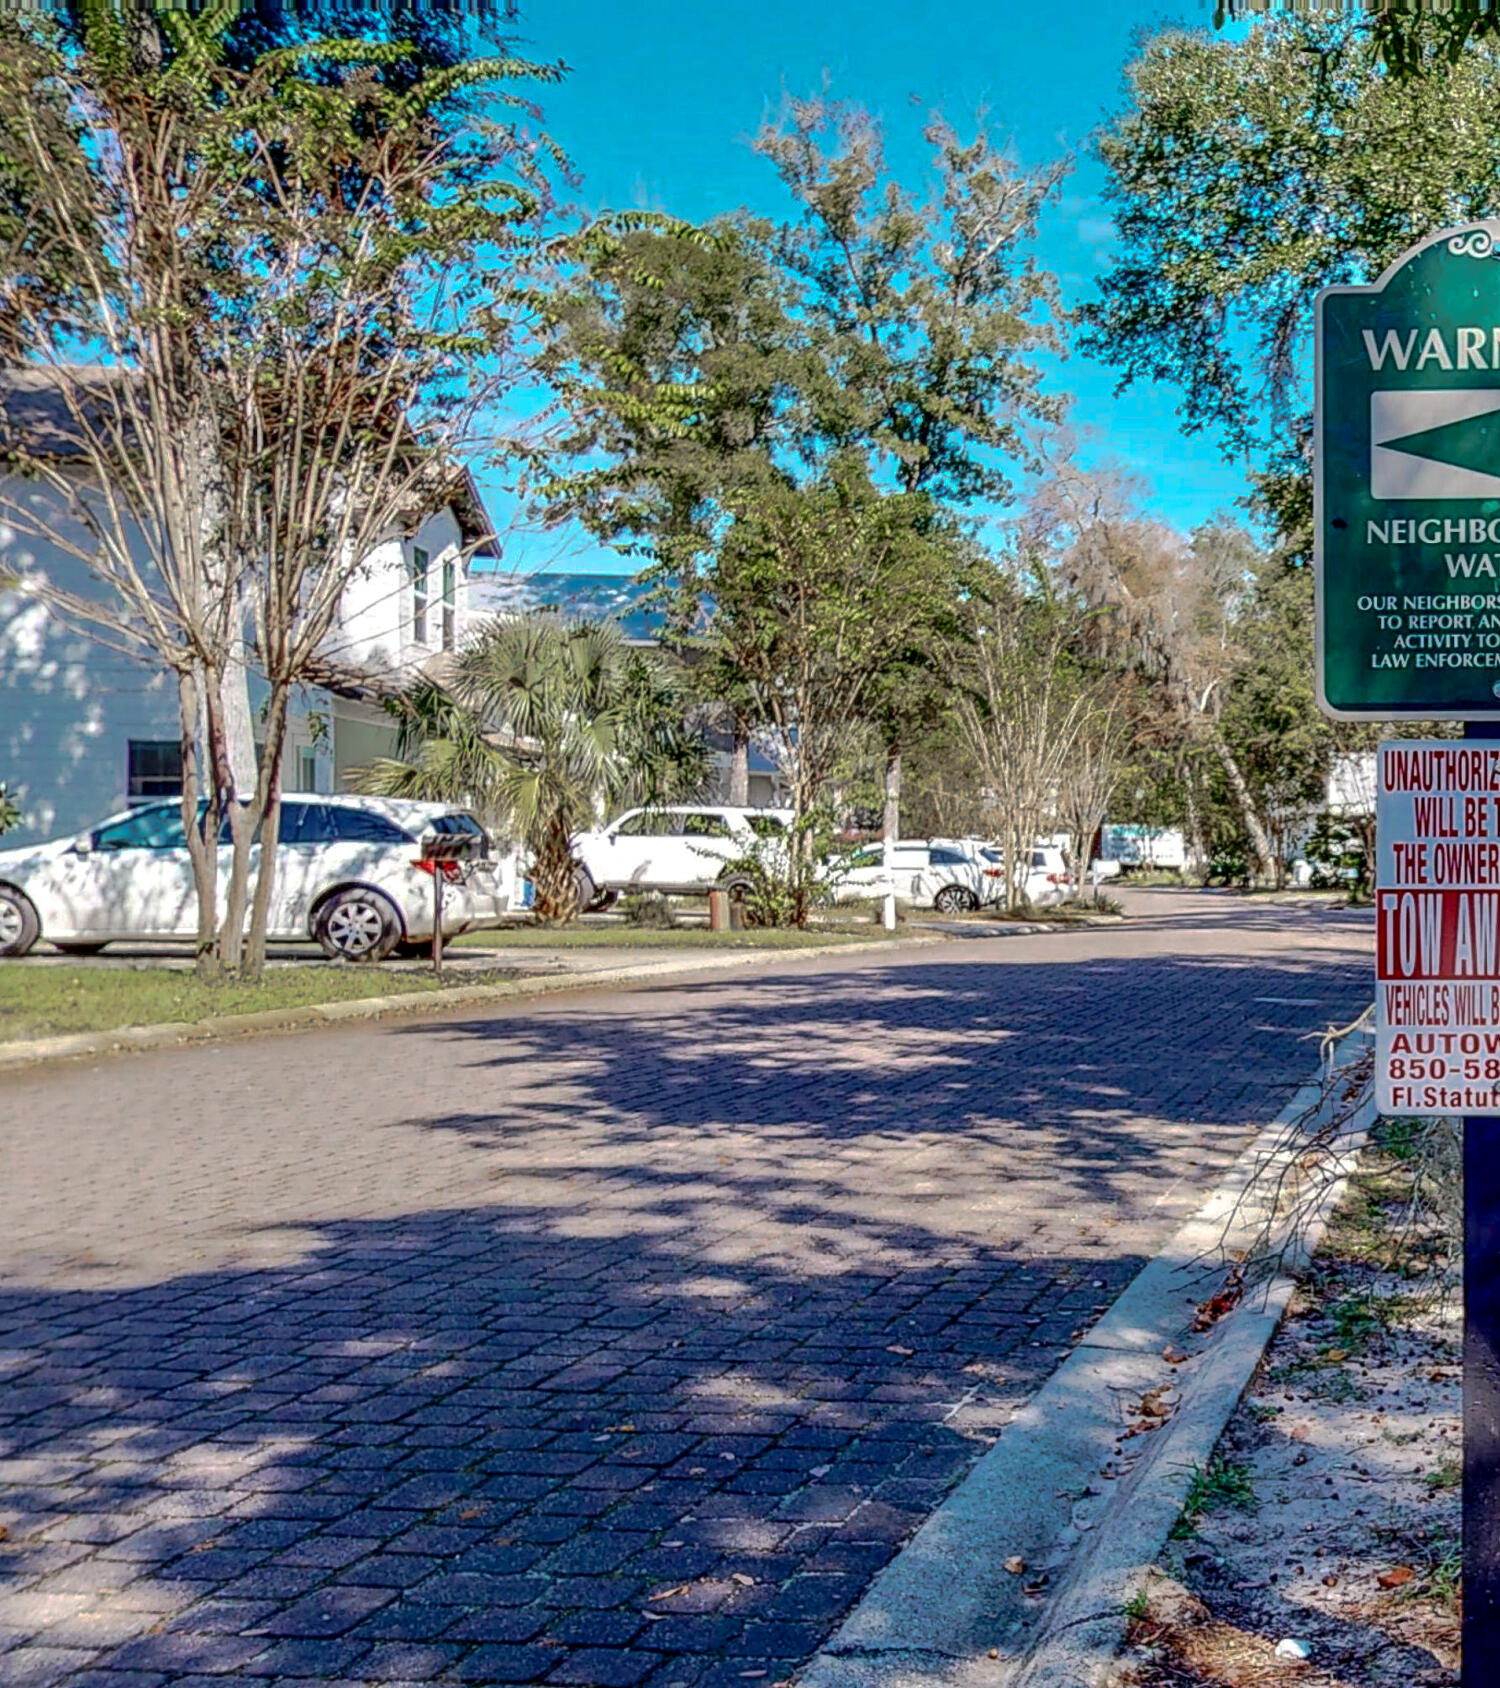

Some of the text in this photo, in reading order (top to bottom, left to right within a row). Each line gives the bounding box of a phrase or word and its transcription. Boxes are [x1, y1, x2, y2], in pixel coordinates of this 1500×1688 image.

[1357, 596, 1397, 610] OUR
[1378, 615, 1402, 629] TO
[1408, 614, 1473, 629] REPORT
[1394, 634, 1473, 648] ACTIVITY
[1475, 633, 1500, 648] TO
[1372, 653, 1410, 668] LAW
[1415, 797, 1458, 838] WILL
[1465, 797, 1488, 838] BE
[1393, 844, 1427, 884] THE
[1382, 891, 1443, 977] TOW
[1385, 985, 1449, 1027] VEHICLES
[1454, 986, 1486, 1026] WILL
